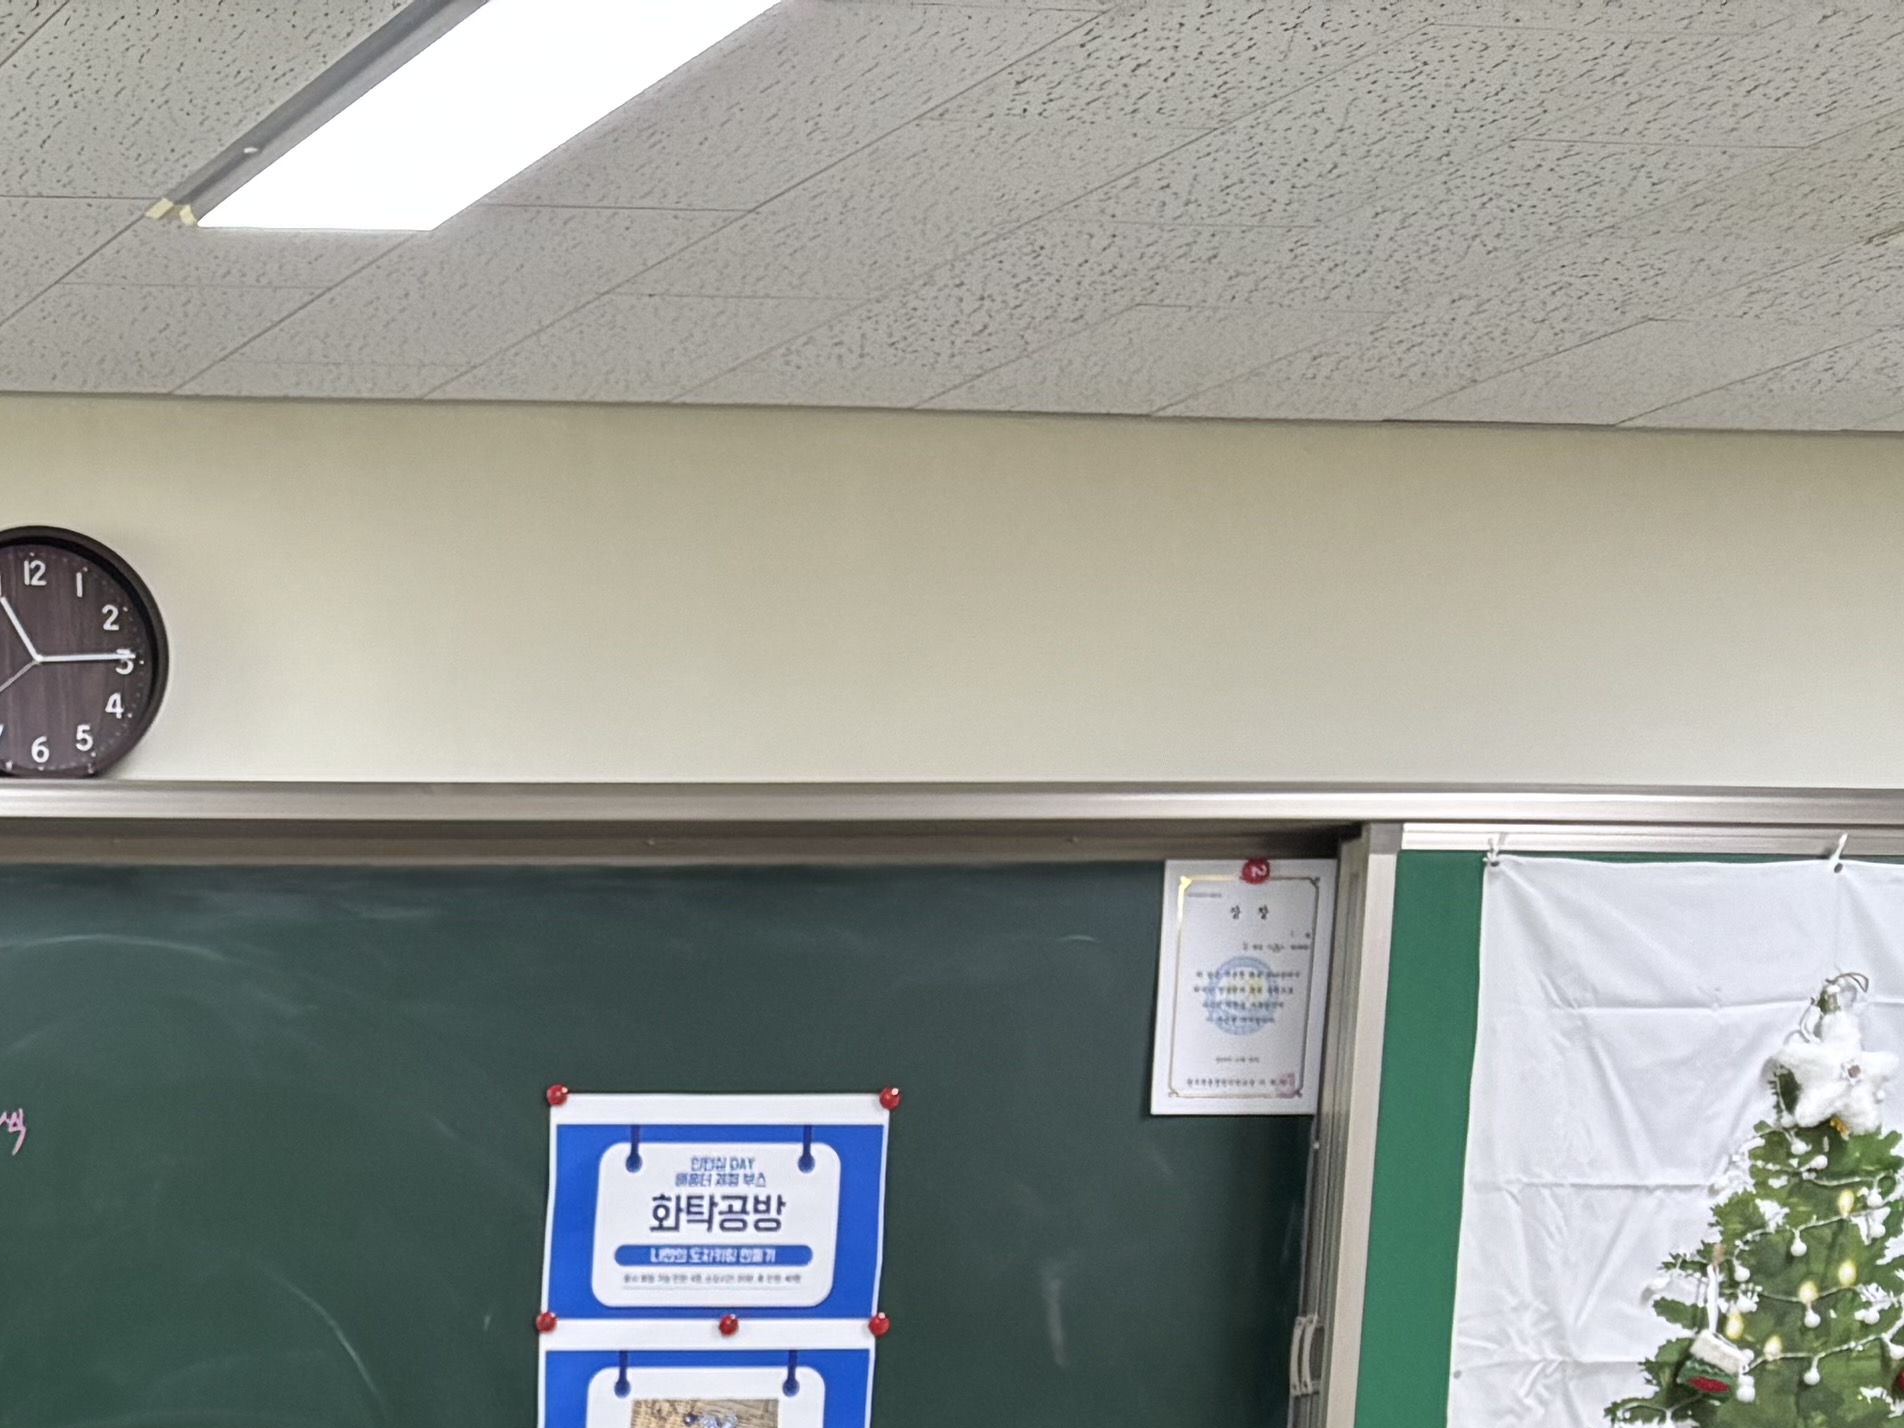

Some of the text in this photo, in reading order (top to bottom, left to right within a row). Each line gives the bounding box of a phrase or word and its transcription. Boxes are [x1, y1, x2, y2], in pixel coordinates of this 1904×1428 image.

[24, 560, 47, 587] 12
[76, 572, 83, 598] 1
[102, 605, 119, 631] 2
[105, 693, 124, 719] 4
[31, 737, 50, 763] 6
[76, 725, 94, 751] 5
[729, 1157, 755, 1171] DAY
[743, 1173, 766, 1187] 부스
[649, 1193, 786, 1233] 화탁공방
